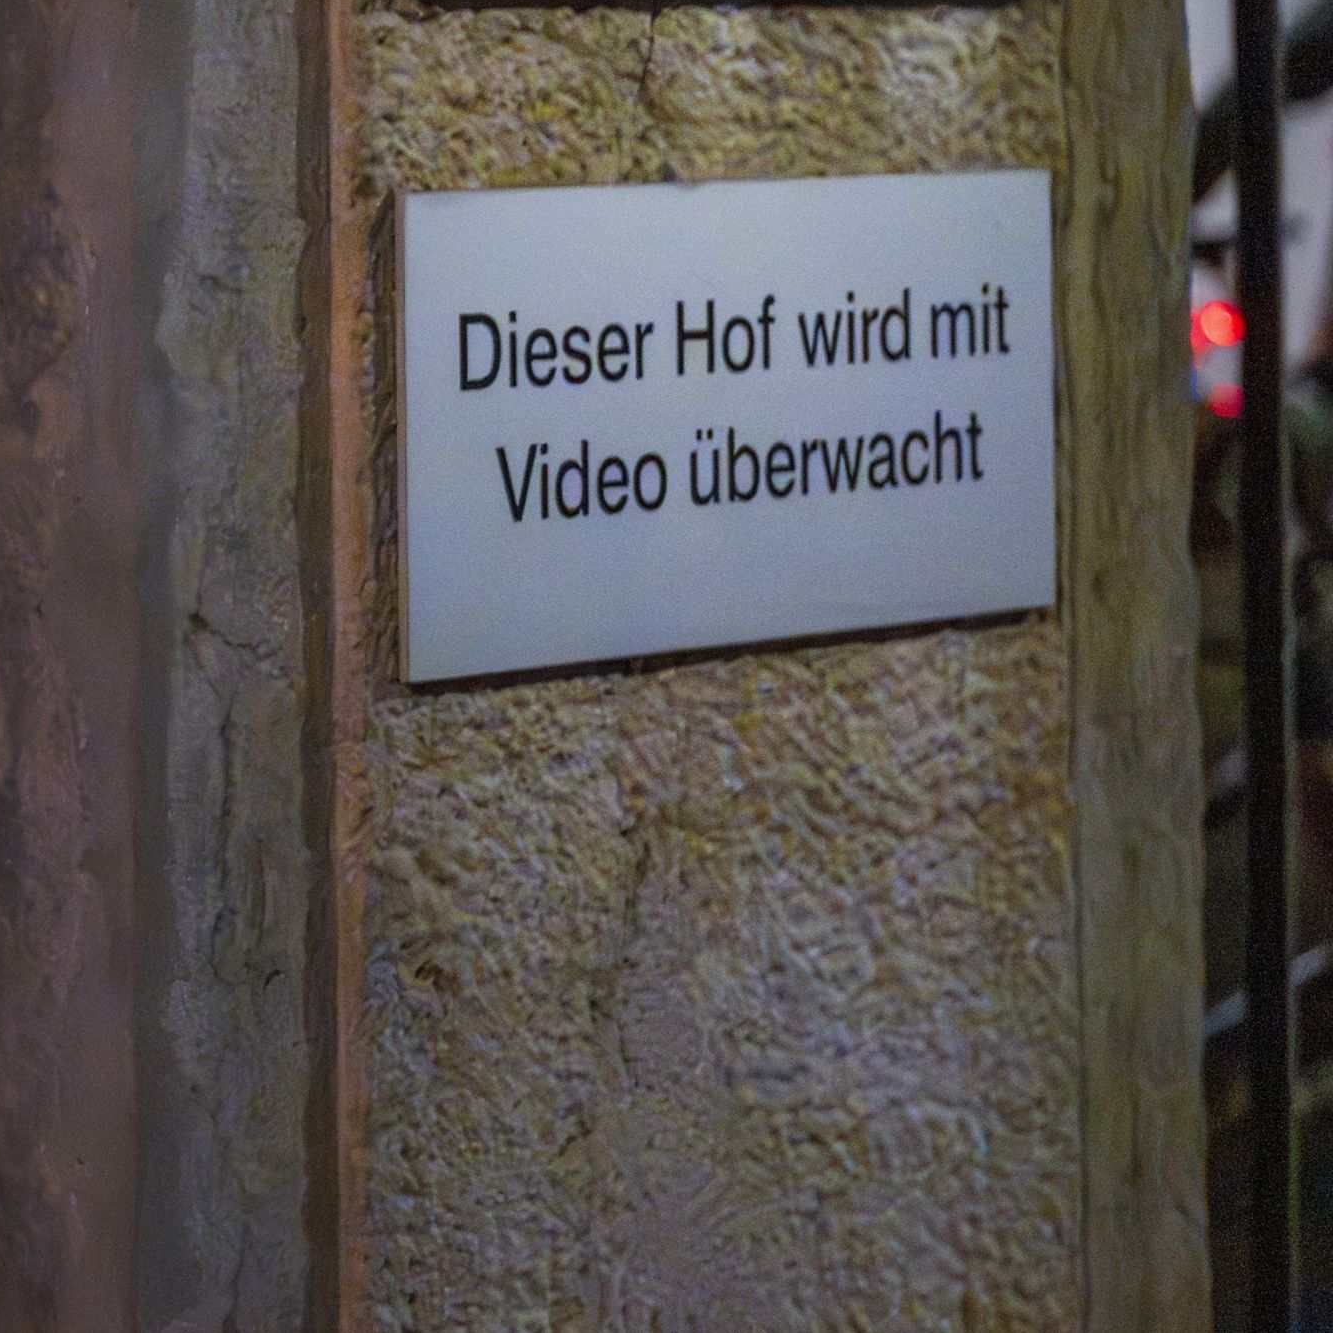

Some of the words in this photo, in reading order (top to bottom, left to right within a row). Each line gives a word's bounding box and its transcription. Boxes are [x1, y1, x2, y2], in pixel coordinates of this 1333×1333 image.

[458, 310, 654, 391] Dieser
[676, 294, 775, 376] Hof
[798, 287, 911, 367] wird
[930, 282, 1011, 358] mit
[495, 440, 668, 523] Video
[689, 410, 984, 506] überwacht
